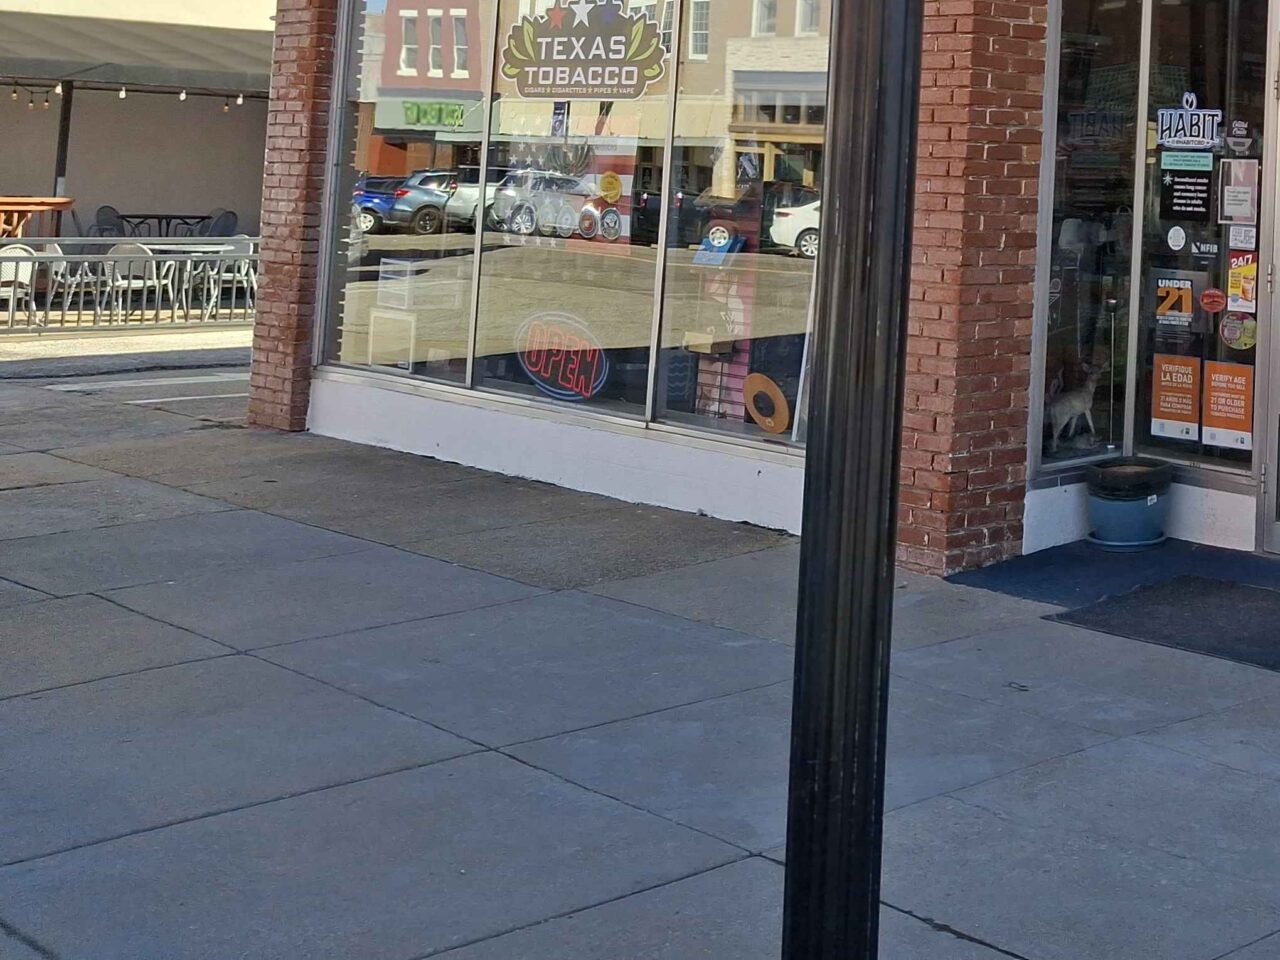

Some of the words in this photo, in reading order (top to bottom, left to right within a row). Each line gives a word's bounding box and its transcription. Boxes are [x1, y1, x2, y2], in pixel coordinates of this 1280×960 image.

[537, 36, 626, 60] TEXAS
[524, 66, 638, 85] TOBACCO
[1159, 112, 1221, 142] HABIT
[1231, 254, 1252, 268] 24/7
[1158, 279, 1191, 288] UNDER
[1156, 288, 1193, 315] 21
[525, 321, 600, 398] OPEN
[1161, 364, 1192, 374] VERIFIQUE
[1161, 372, 1171, 381] LA
[1172, 373, 1193, 383] EDAD
[1211, 373, 1232, 382] VERIFY
[1234, 376, 1246, 384] AGE
[1226, 398, 1245, 407] OLDER
[1218, 405, 1245, 414] PURCHASE
